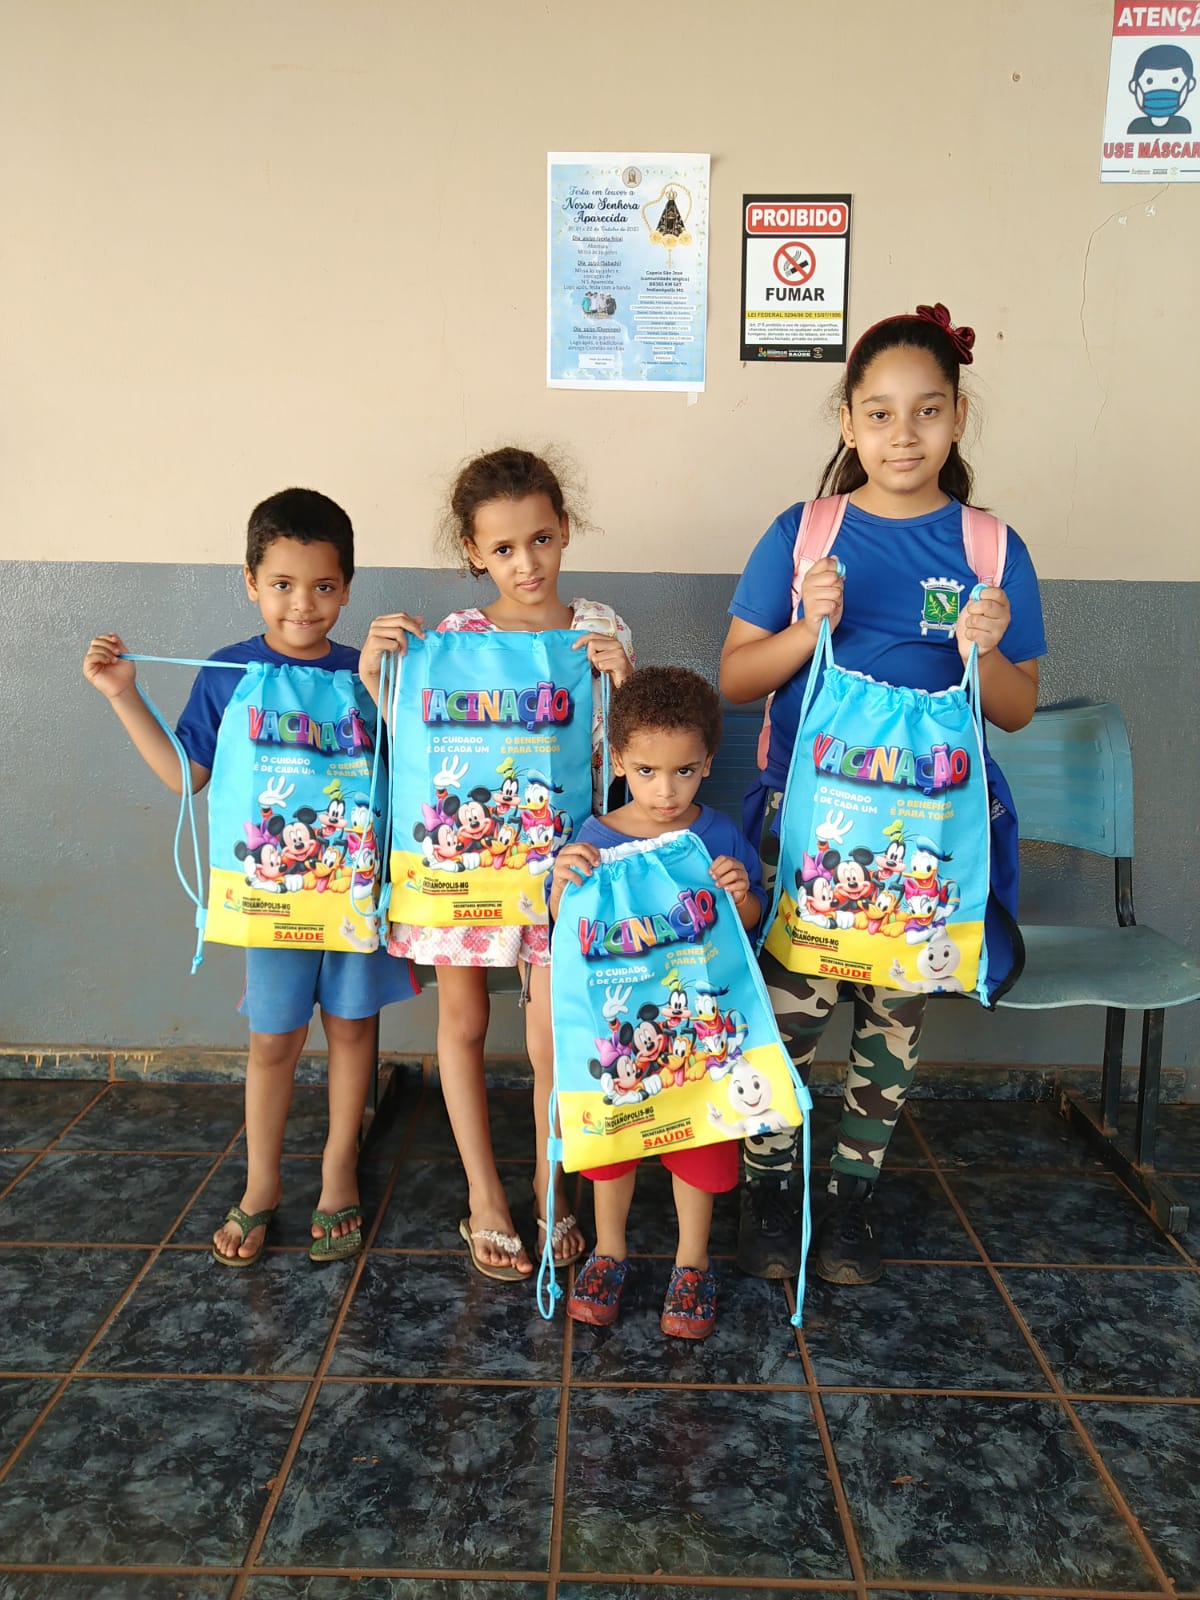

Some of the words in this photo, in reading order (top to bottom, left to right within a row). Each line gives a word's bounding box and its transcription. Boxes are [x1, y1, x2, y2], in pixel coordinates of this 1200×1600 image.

[1103, 142, 1135, 159] USE
[562, 197, 596, 210] Nossa
[598, 197, 640, 210] Senhora
[574, 210, 628, 224] Aparecida
[751, 208, 842, 227] PROIBIDO
[766, 288, 825, 302] FUMAR
[270, 756, 310, 766] CUIDADO
[813, 732, 968, 796] VACINAÇÃO
[260, 765, 272, 773] DE
[274, 766, 299, 774] CADA
[829, 788, 872, 804] CUIDADO
[820, 796, 832, 804] DE
[834, 800, 860, 811] CADA
[862, 805, 878, 814] UM
[896, 799, 906, 807] O
[898, 810, 926, 818] PARA
[454, 908, 502, 918] SAÚDE
[274, 930, 324, 940] SAÚDE
[596, 970, 604, 978] O
[605, 966, 648, 977] CUIDADO
[611, 976, 638, 984] CADA
[643, 1126, 694, 1148] SAÚDE
